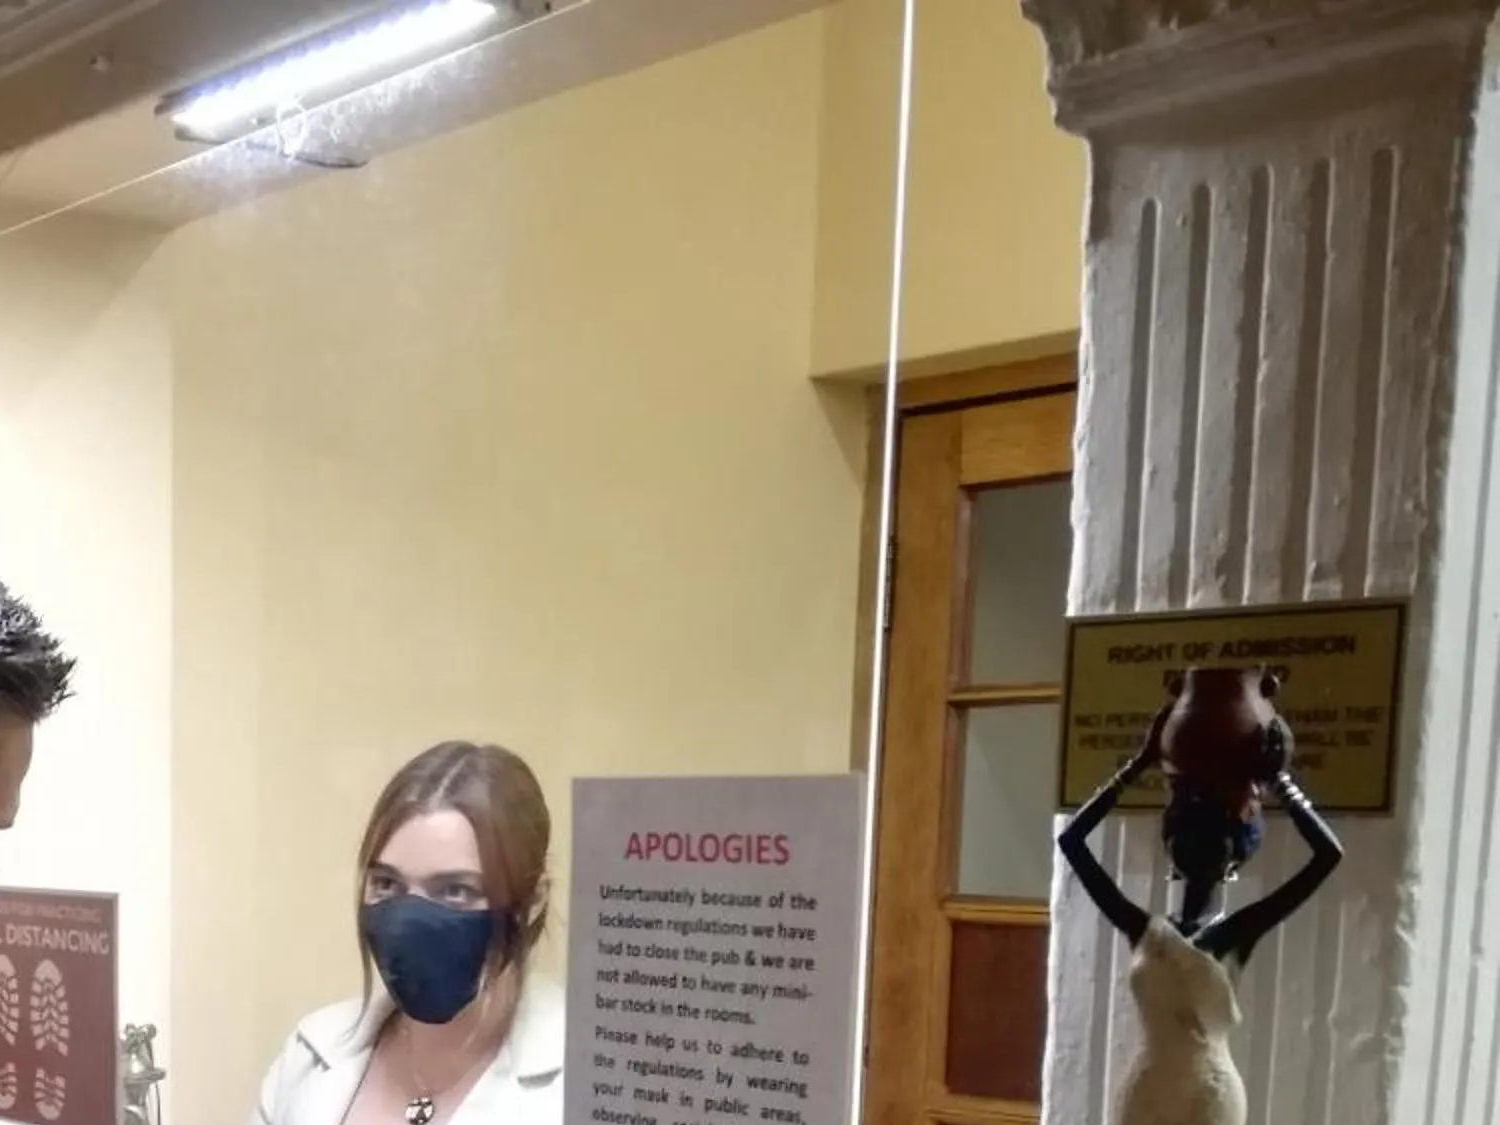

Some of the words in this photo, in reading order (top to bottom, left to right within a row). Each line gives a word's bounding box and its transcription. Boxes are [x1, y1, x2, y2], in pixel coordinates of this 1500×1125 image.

[1107, 643, 1176, 664] RIGHT
[1183, 640, 1214, 661] OF
[624, 831, 790, 866] APOLOGIES
[599, 884, 695, 907] Unfortunately
[701, 889, 762, 908] because
[767, 891, 785, 910] of
[789, 893, 818, 911] the
[6, 923, 109, 955] DISTANCING
[598, 912, 664, 930] lockdown
[667, 918, 748, 937] regulations
[751, 925, 774, 938] we
[777, 922, 817, 942] have
[597, 940, 623, 956] had
[626, 944, 641, 958] to
[645, 944, 679, 961] close
[683, 946, 708, 962] the
[710, 948, 740, 967] pub
[744, 950, 757, 967] &
[761, 955, 785, 969] we
[788, 957, 816, 971] are
[596, 969, 620, 984] not
[623, 970, 678, 989] allowed
[681, 975, 697, 991] to
[700, 974, 737, 994] have
[739, 982, 769, 1001] any
[595, 995, 619, 1010] bar
[622, 997, 657, 1015] stock
[660, 1002, 675, 1017] in
[677, 1002, 702, 1020] the
[704, 1008, 756, 1026] rooms.
[594, 1026, 638, 1046] Please
[645, 1033, 676, 1053] help
[682, 1039, 699, 1054] us
[706, 1039, 723, 1056] to
[729, 1041, 785, 1064] adhere
[791, 1050, 810, 1067] to
[593, 1053, 616, 1069] the
[627, 1059, 705, 1082] regulations
[715, 1067, 734, 1089] by
[745, 1075, 808, 1101] wearing
[592, 1082, 624, 1098] your
[633, 1087, 670, 1105] mask
[679, 1091, 694, 1108] in
[705, 1097, 750, 1118] public
